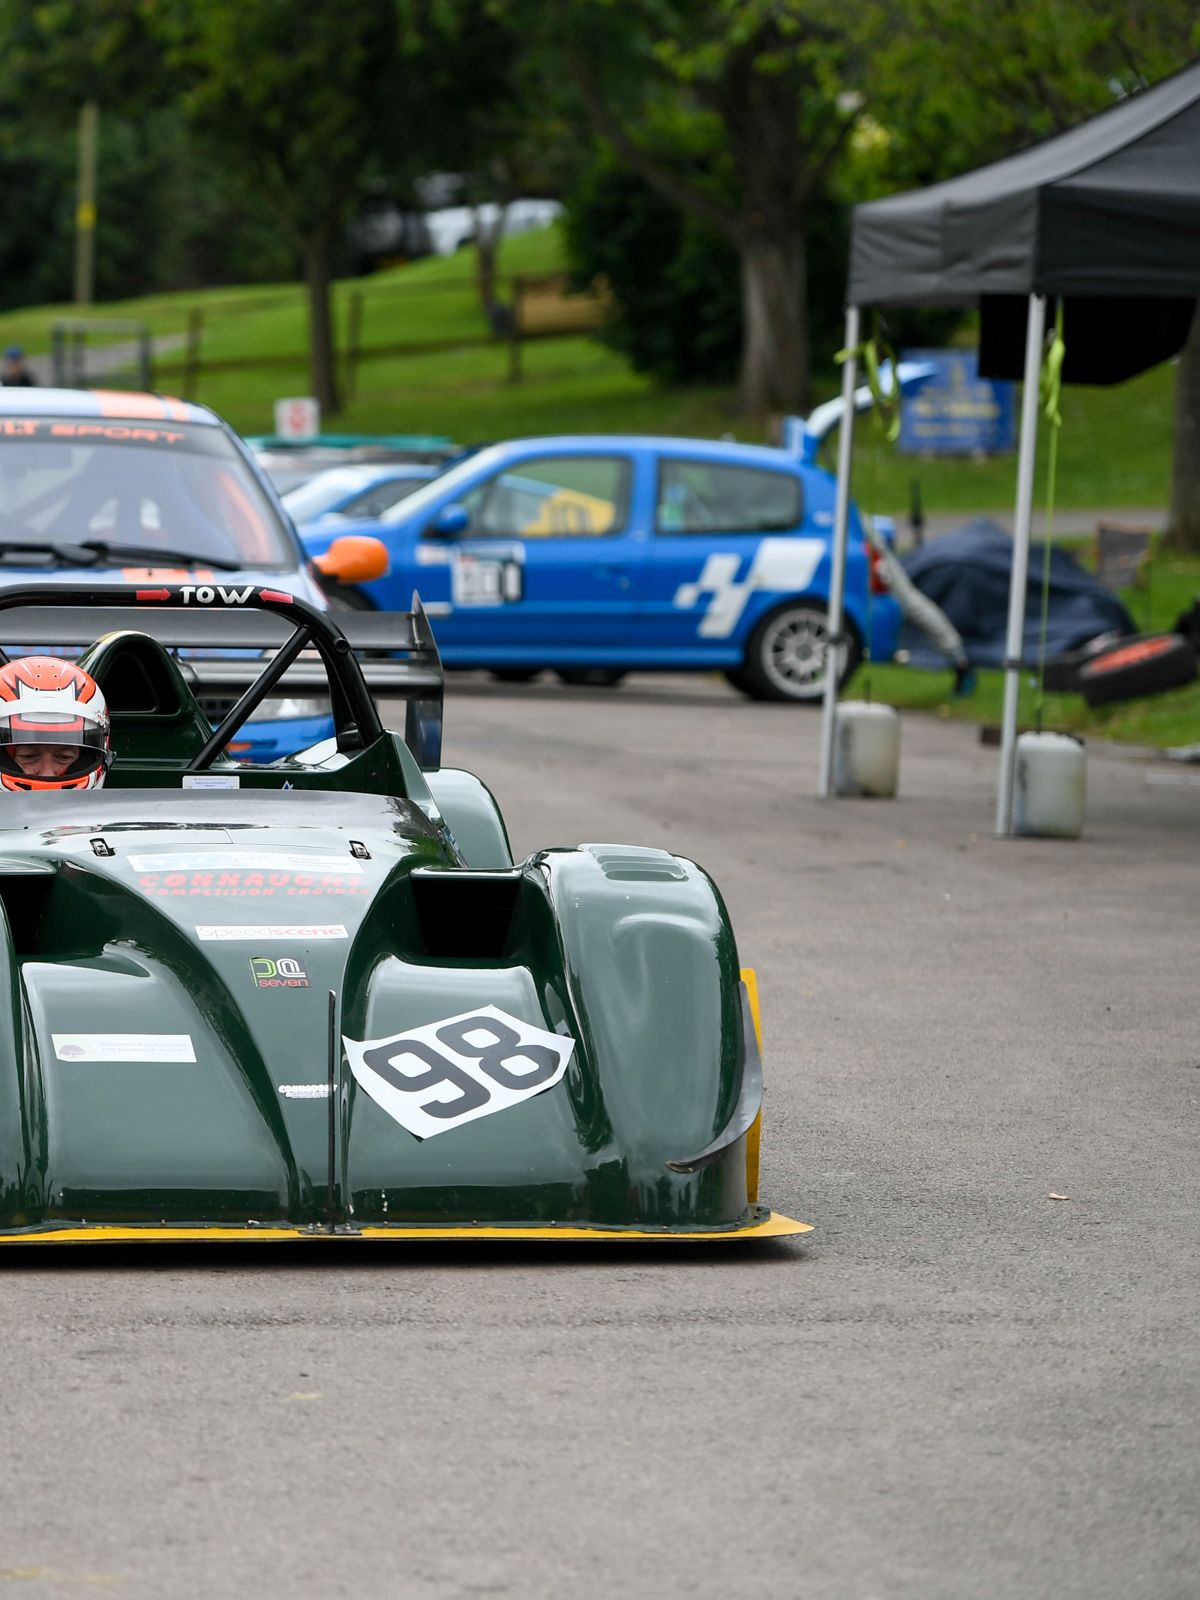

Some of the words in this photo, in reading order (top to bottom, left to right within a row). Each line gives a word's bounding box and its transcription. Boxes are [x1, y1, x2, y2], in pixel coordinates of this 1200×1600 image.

[51, 424, 186, 444] SPORT
[179, 586, 256, 604] TOW
[139, 873, 365, 887] CONNAUGHT
[144, 887, 276, 896] COMPETITION
[287, 886, 372, 896] ENGINES
[200, 926, 344, 940] Speedscene
[258, 979, 309, 988] seven
[363, 1016, 560, 1119] 98
